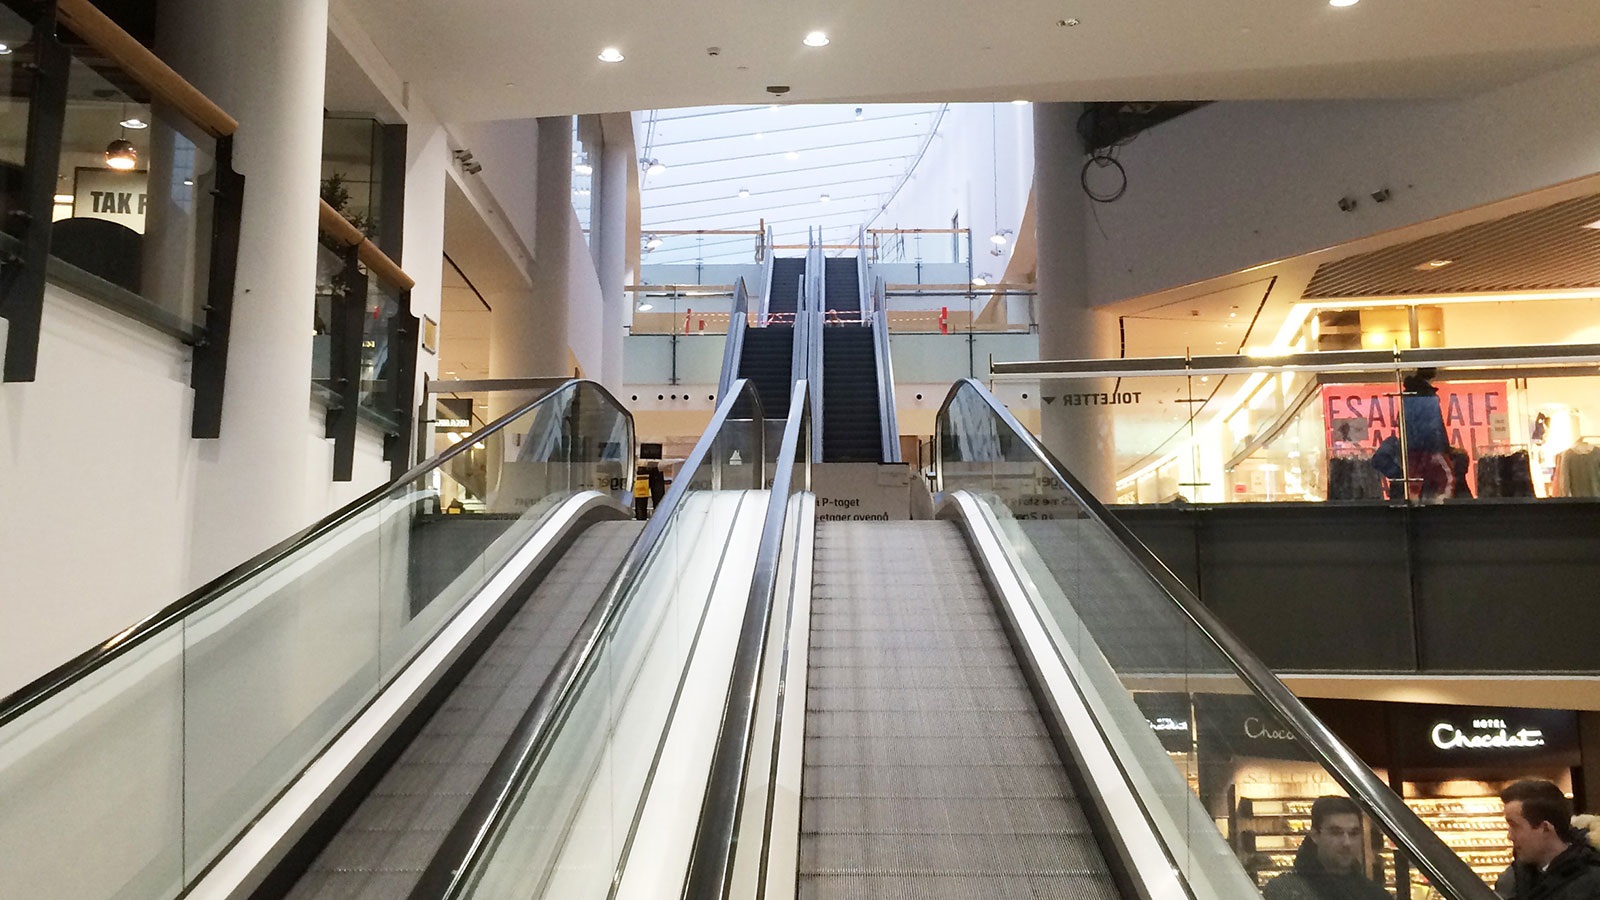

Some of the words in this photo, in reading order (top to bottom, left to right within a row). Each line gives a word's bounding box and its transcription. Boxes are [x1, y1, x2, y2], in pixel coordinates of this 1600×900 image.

[90, 191, 132, 214] TAK
[822, 497, 860, 509] P-taget
[1472, 718, 1507, 729] HOTEL
